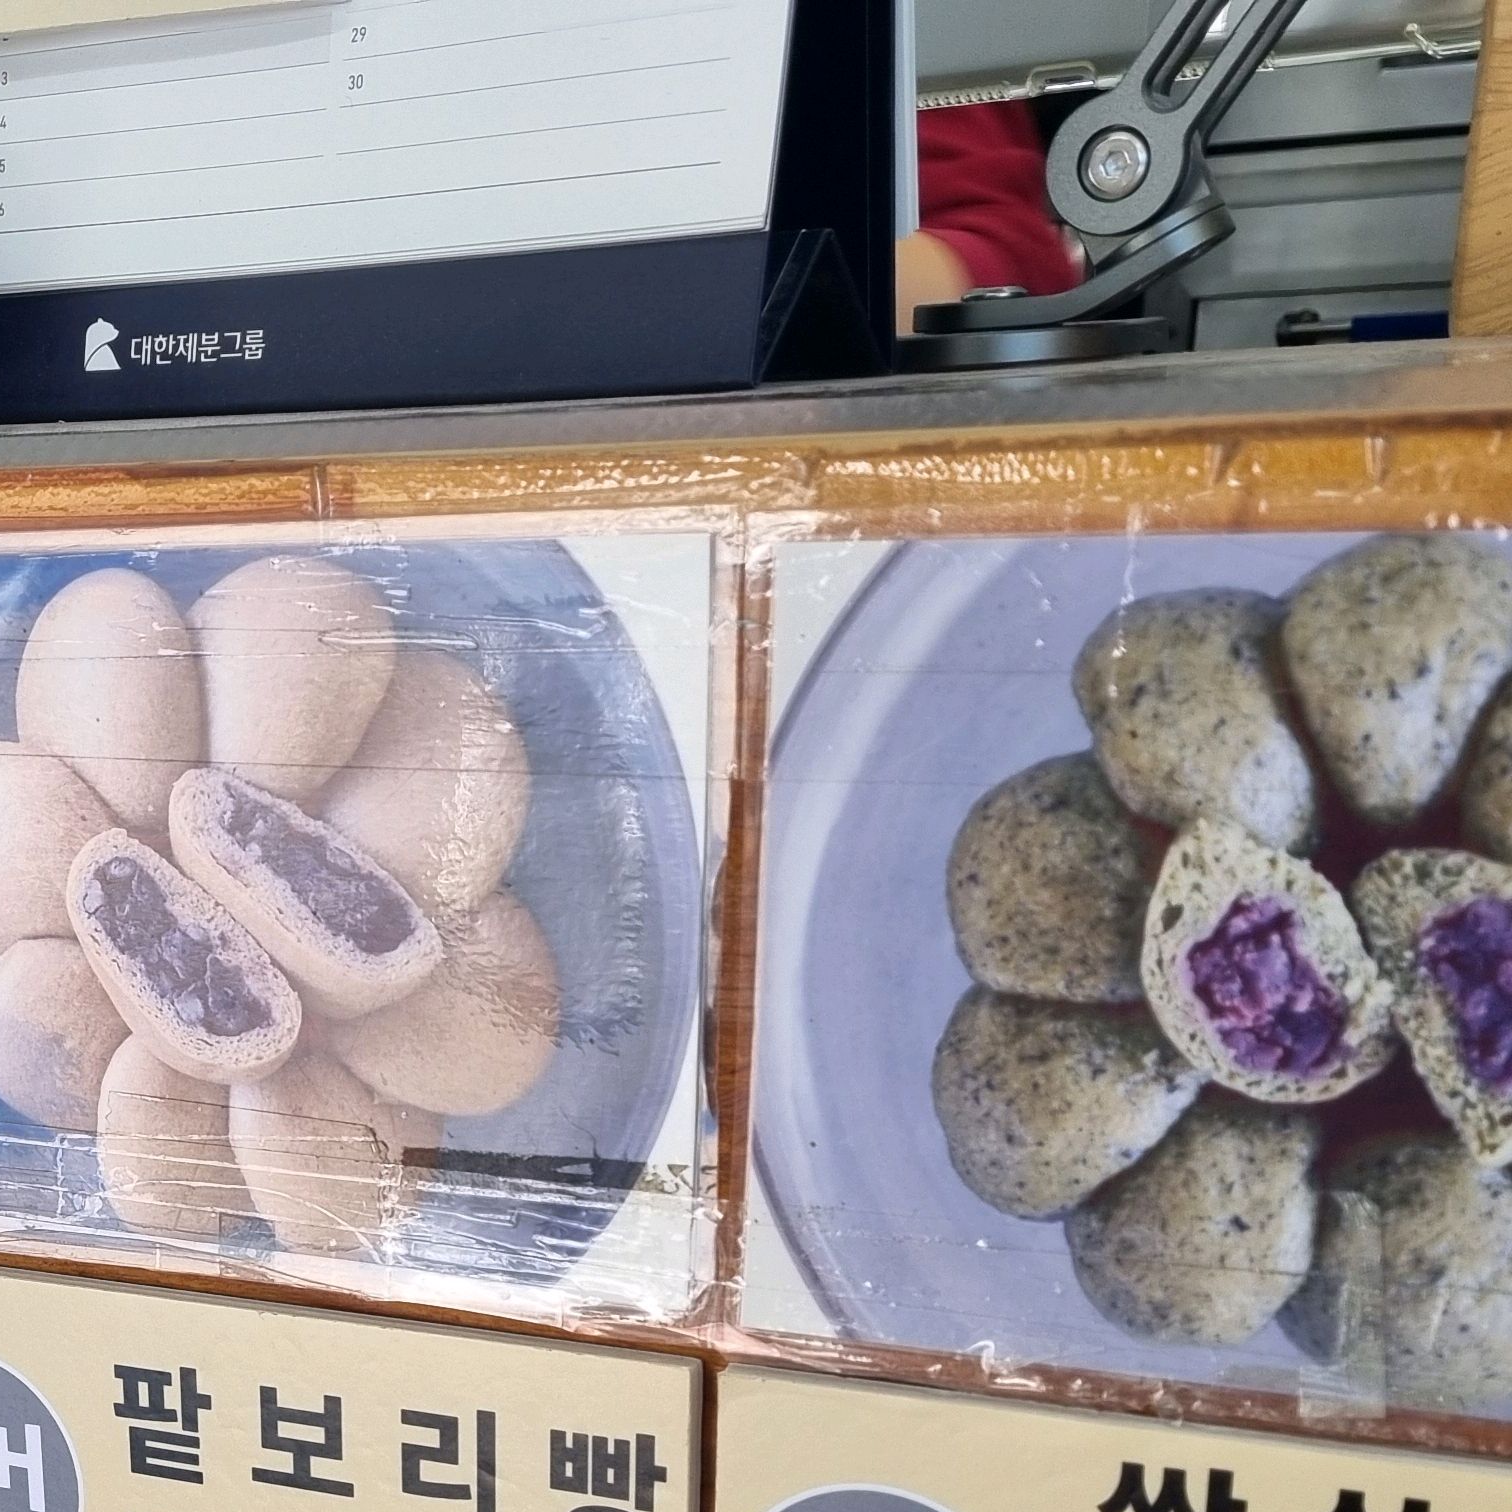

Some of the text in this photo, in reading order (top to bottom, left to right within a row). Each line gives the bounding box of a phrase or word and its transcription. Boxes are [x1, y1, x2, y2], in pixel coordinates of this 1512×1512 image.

[350, 26, 368, 44] 29
[347, 73, 364, 91] 30
[129, 328, 266, 368] 대한제분그룹
